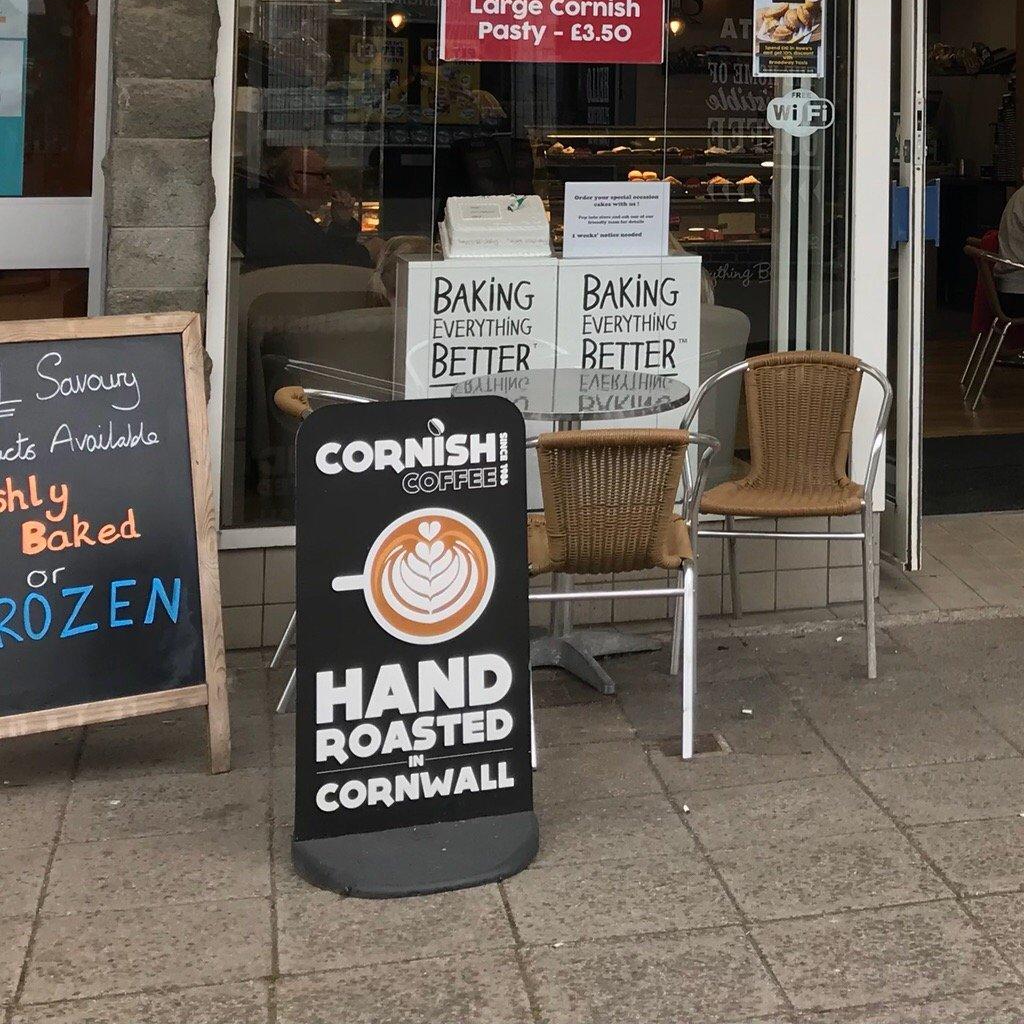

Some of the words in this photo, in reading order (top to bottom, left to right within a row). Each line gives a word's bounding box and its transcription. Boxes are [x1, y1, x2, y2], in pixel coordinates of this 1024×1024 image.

[478, 21, 547, 46] Pasty
[571, 23, 632, 42] £3.50
[434, 277, 534, 314] BAKING
[583, 274, 679, 310] BAKING
[433, 317, 532, 339] EVERYTHING
[583, 313, 677, 334] EVERYTHING
[36, 352, 141, 411] Savoury
[50, 421, 160, 454] Available
[316, 430, 496, 475] CORNISH
[500, 432, 508, 461] SINCE
[402, 467, 497, 494] COFFEE
[22, 508, 141, 556] Baked
[27, 567, 66, 588] or
[316, 653, 513, 724] HAND
[316, 708, 514, 765] ROASTED
[408, 754, 424, 768] IN
[316, 761, 514, 812] CORNWALL
